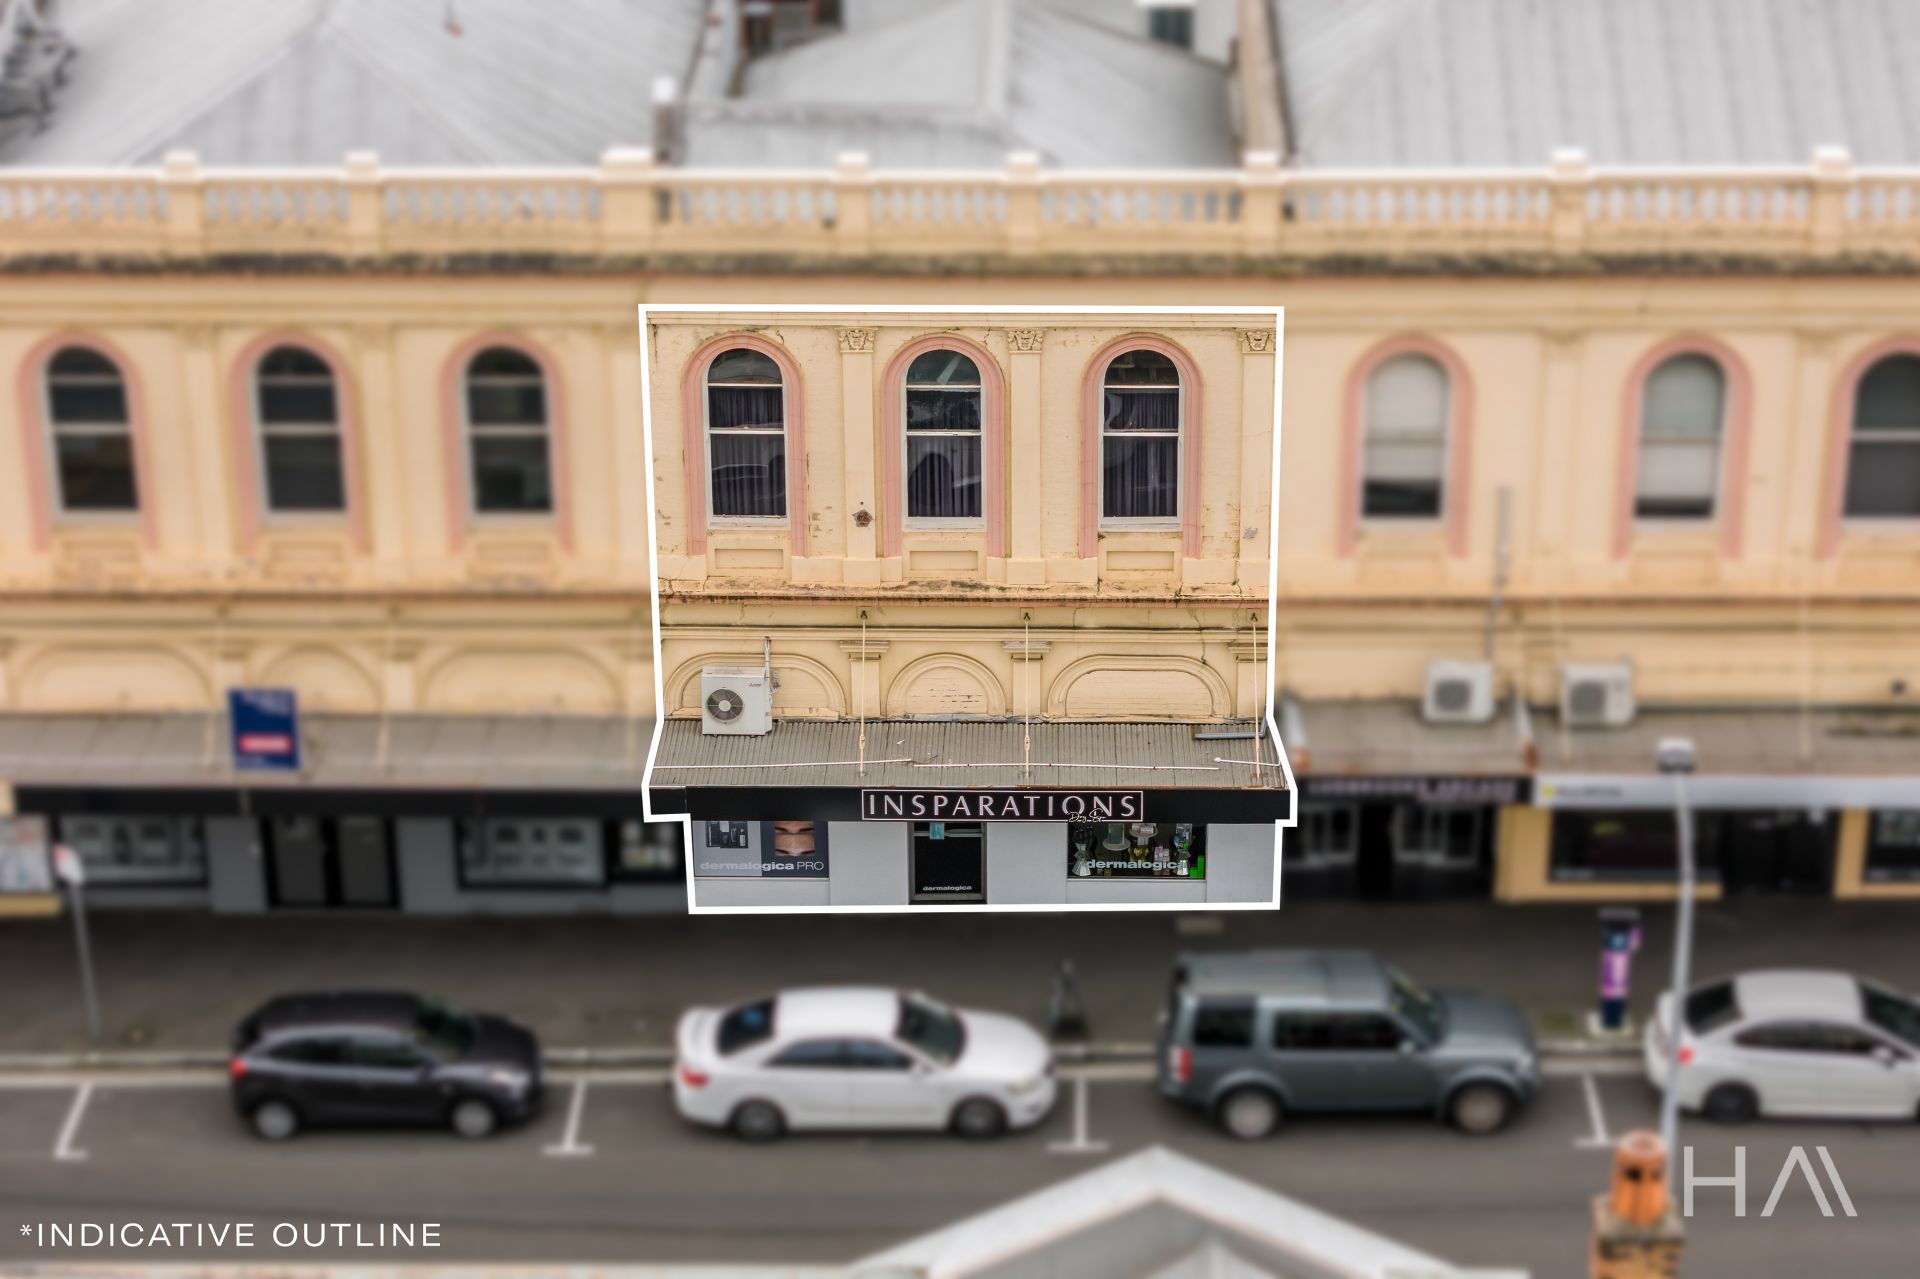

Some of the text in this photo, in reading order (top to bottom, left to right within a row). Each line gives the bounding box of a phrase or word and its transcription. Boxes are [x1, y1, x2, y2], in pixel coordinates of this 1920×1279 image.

[869, 794, 1135, 817] INSPARATIONS
[700, 861, 824, 871] dermalogica PRO
[1086, 859, 1188, 870] dermalogica
